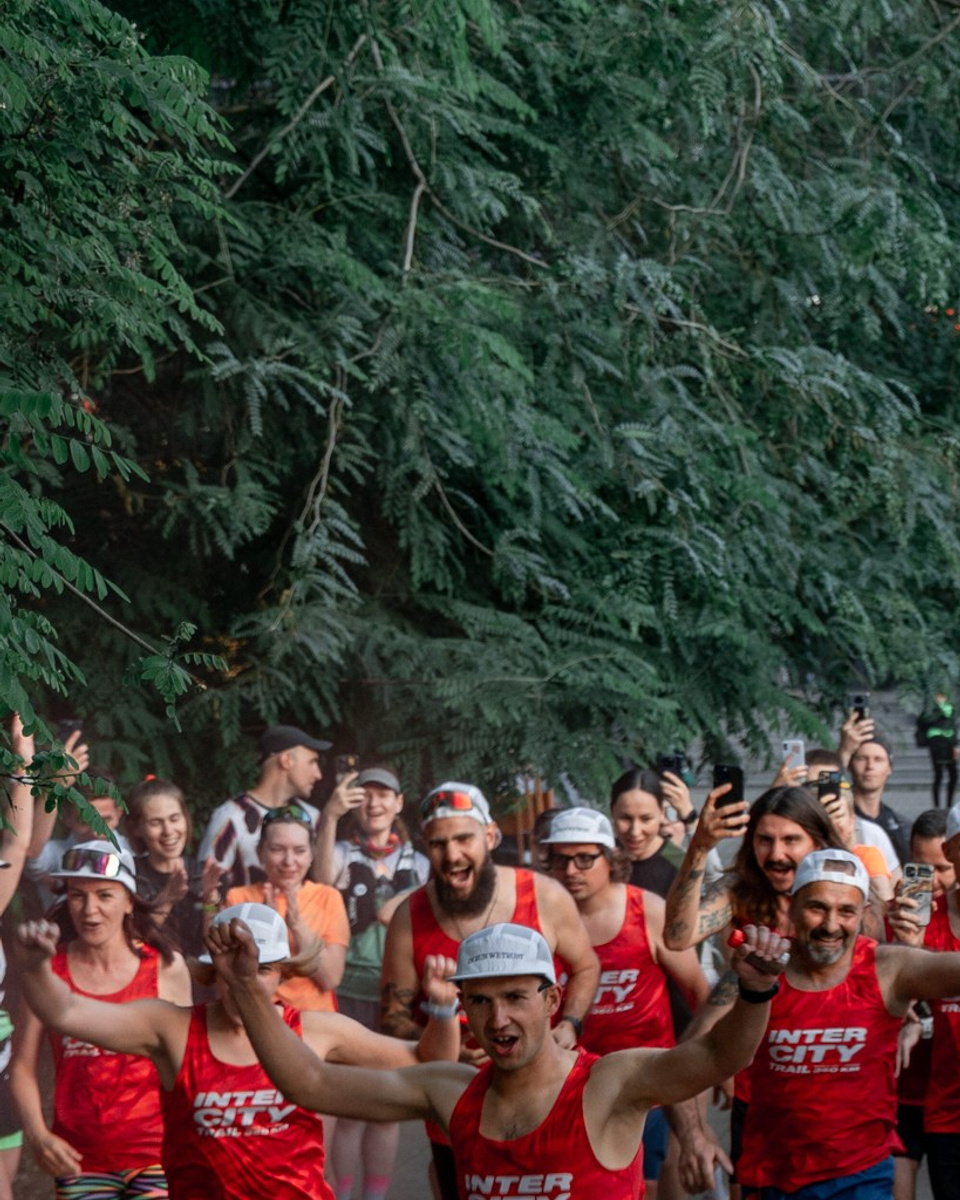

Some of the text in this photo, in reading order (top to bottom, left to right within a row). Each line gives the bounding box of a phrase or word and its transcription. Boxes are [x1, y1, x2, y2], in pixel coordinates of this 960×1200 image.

[767, 1026, 868, 1045] INTER
[768, 1043, 866, 1064] CITY
[769, 1061, 811, 1074] TRAIL
[193, 1104, 298, 1128] CITY
[464, 1171, 574, 1195] INTER
